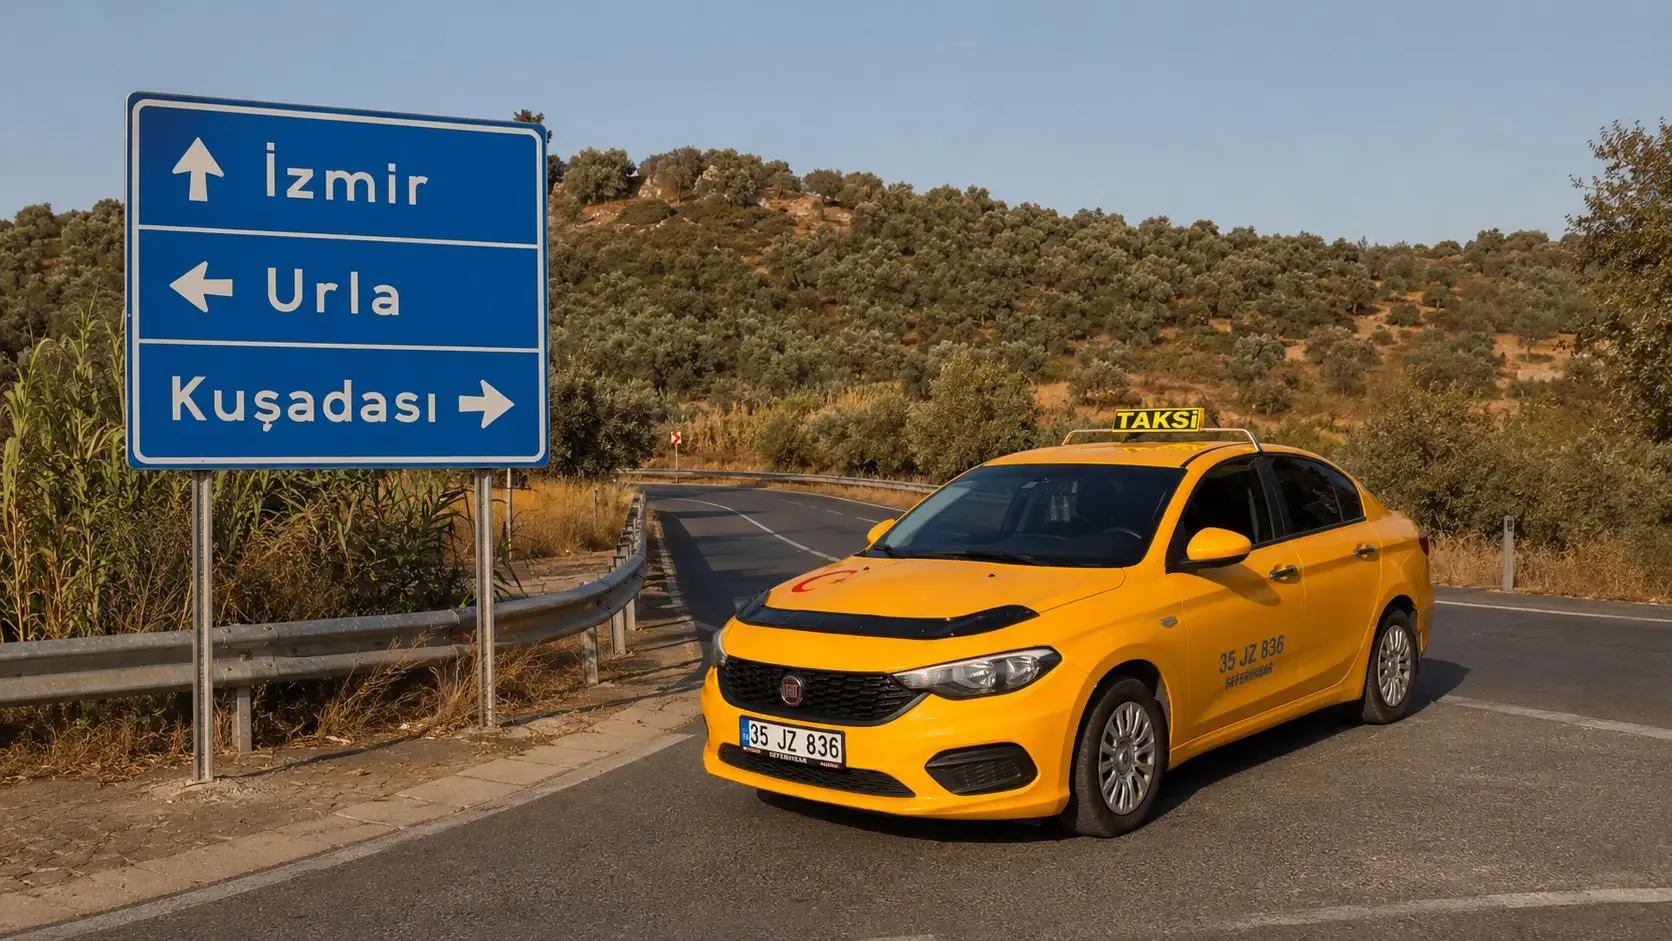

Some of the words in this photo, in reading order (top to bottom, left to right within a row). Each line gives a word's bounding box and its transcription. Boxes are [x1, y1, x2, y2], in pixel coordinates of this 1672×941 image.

[266, 142, 429, 206] İzmir
[267, 267, 400, 316] Urla
[171, 375, 436, 433] Kuşadası
[1219, 649, 1236, 674] 35
[1240, 643, 1257, 667] JZ
[1261, 634, 1284, 660] 836
[750, 723, 769, 747] 35
[777, 728, 797, 753] JZ
[806, 733, 839, 759] 836
